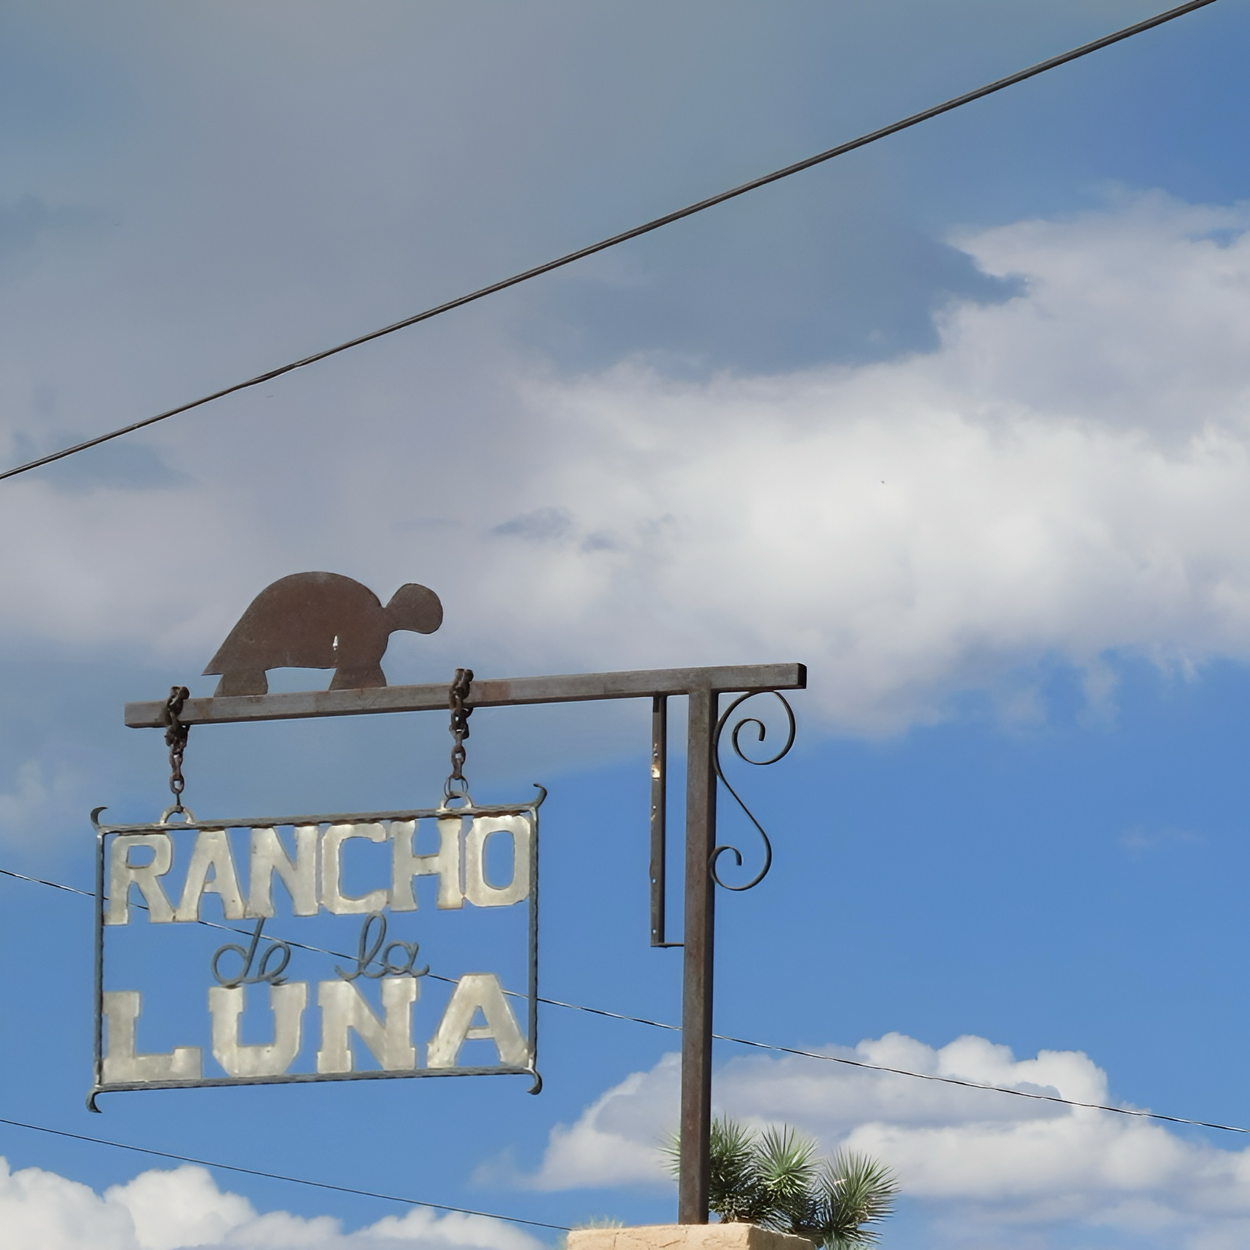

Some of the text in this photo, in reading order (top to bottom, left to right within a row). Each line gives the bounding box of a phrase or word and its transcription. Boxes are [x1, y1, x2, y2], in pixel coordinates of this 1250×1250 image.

[102, 815, 531, 925] RANCHO
[211, 910, 430, 985] de la
[102, 972, 530, 1084] LUNA
